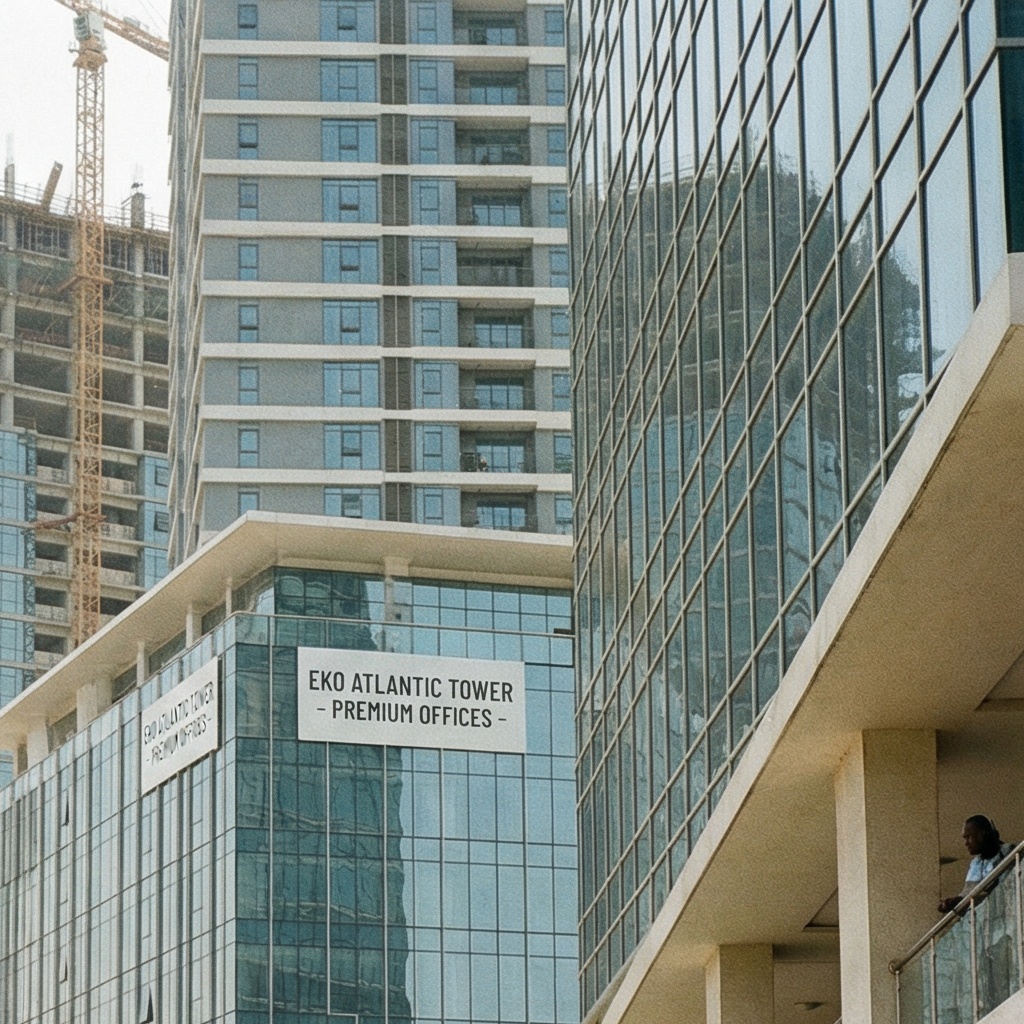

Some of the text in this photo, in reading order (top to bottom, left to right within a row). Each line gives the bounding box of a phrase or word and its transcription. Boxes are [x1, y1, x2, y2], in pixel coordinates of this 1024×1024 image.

[309, 669, 514, 703] EKO ATLANTIC TOWER
[332, 699, 413, 723] PREMIUM
[419, 704, 493, 728] OFFICES
